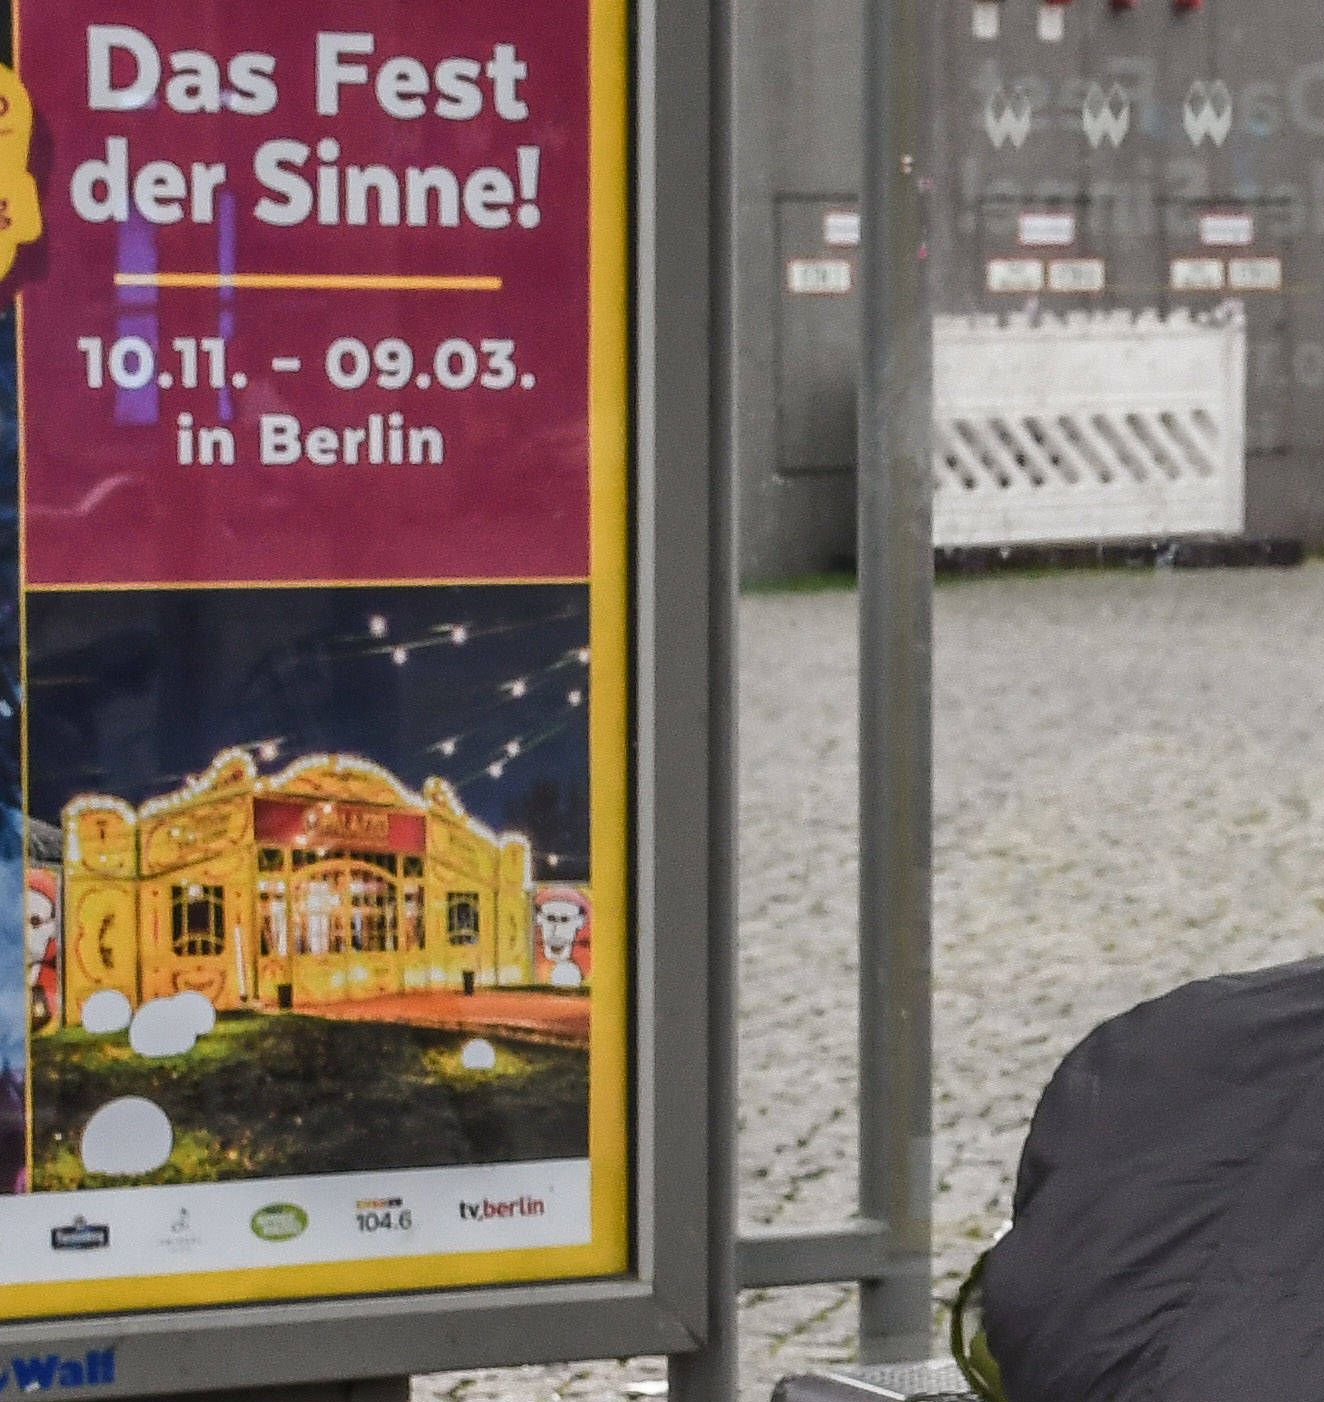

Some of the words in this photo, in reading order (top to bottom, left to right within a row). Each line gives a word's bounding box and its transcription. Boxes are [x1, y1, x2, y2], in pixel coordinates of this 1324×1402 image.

[86, 24, 279, 114] Das
[314, 31, 530, 122] Fest
[69, 136, 227, 224] der
[252, 137, 541, 229] Sinne!
[77, 336, 248, 390] 10.11.
[324, 336, 537, 391] 09.03.
[177, 412, 236, 467] in
[258, 412, 445, 467] Berlin
[356, 1209, 413, 1233] 104.6
[11, 1350, 117, 1392] Wall
